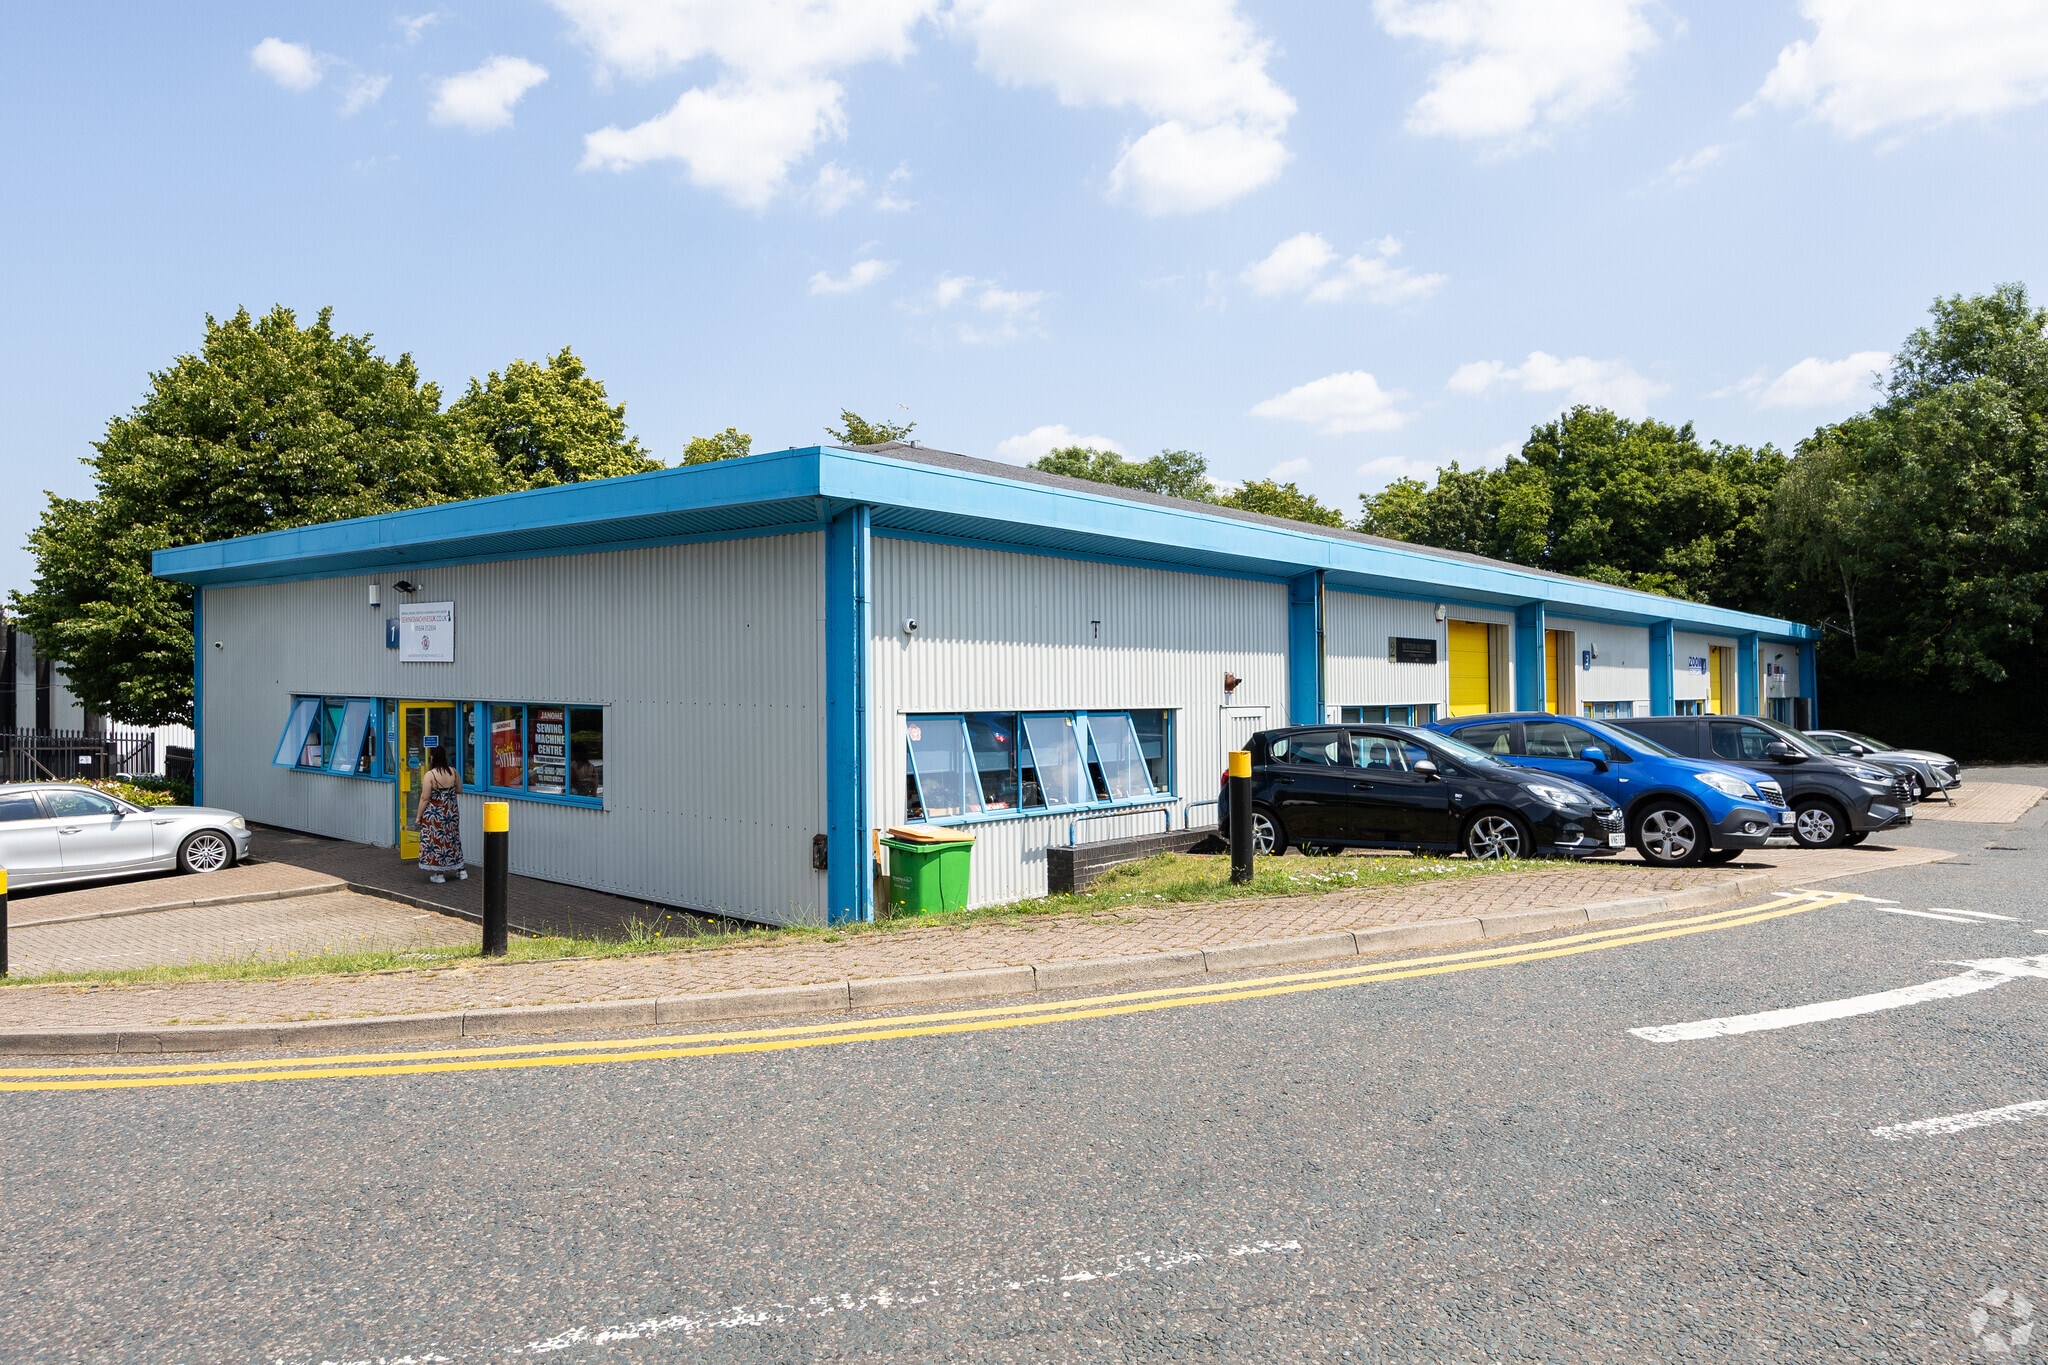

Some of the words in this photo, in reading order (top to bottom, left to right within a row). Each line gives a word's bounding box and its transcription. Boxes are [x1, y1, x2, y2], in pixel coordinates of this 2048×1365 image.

[391, 625, 396, 642] 1
[1390, 642, 1395, 656] 2
[1585, 654, 1589, 666] 3
[540, 711, 563, 720] JANOME
[536, 723, 563, 734] SEWING
[535, 733, 565, 745] MACHINE
[537, 744, 563, 756] CENTRE
